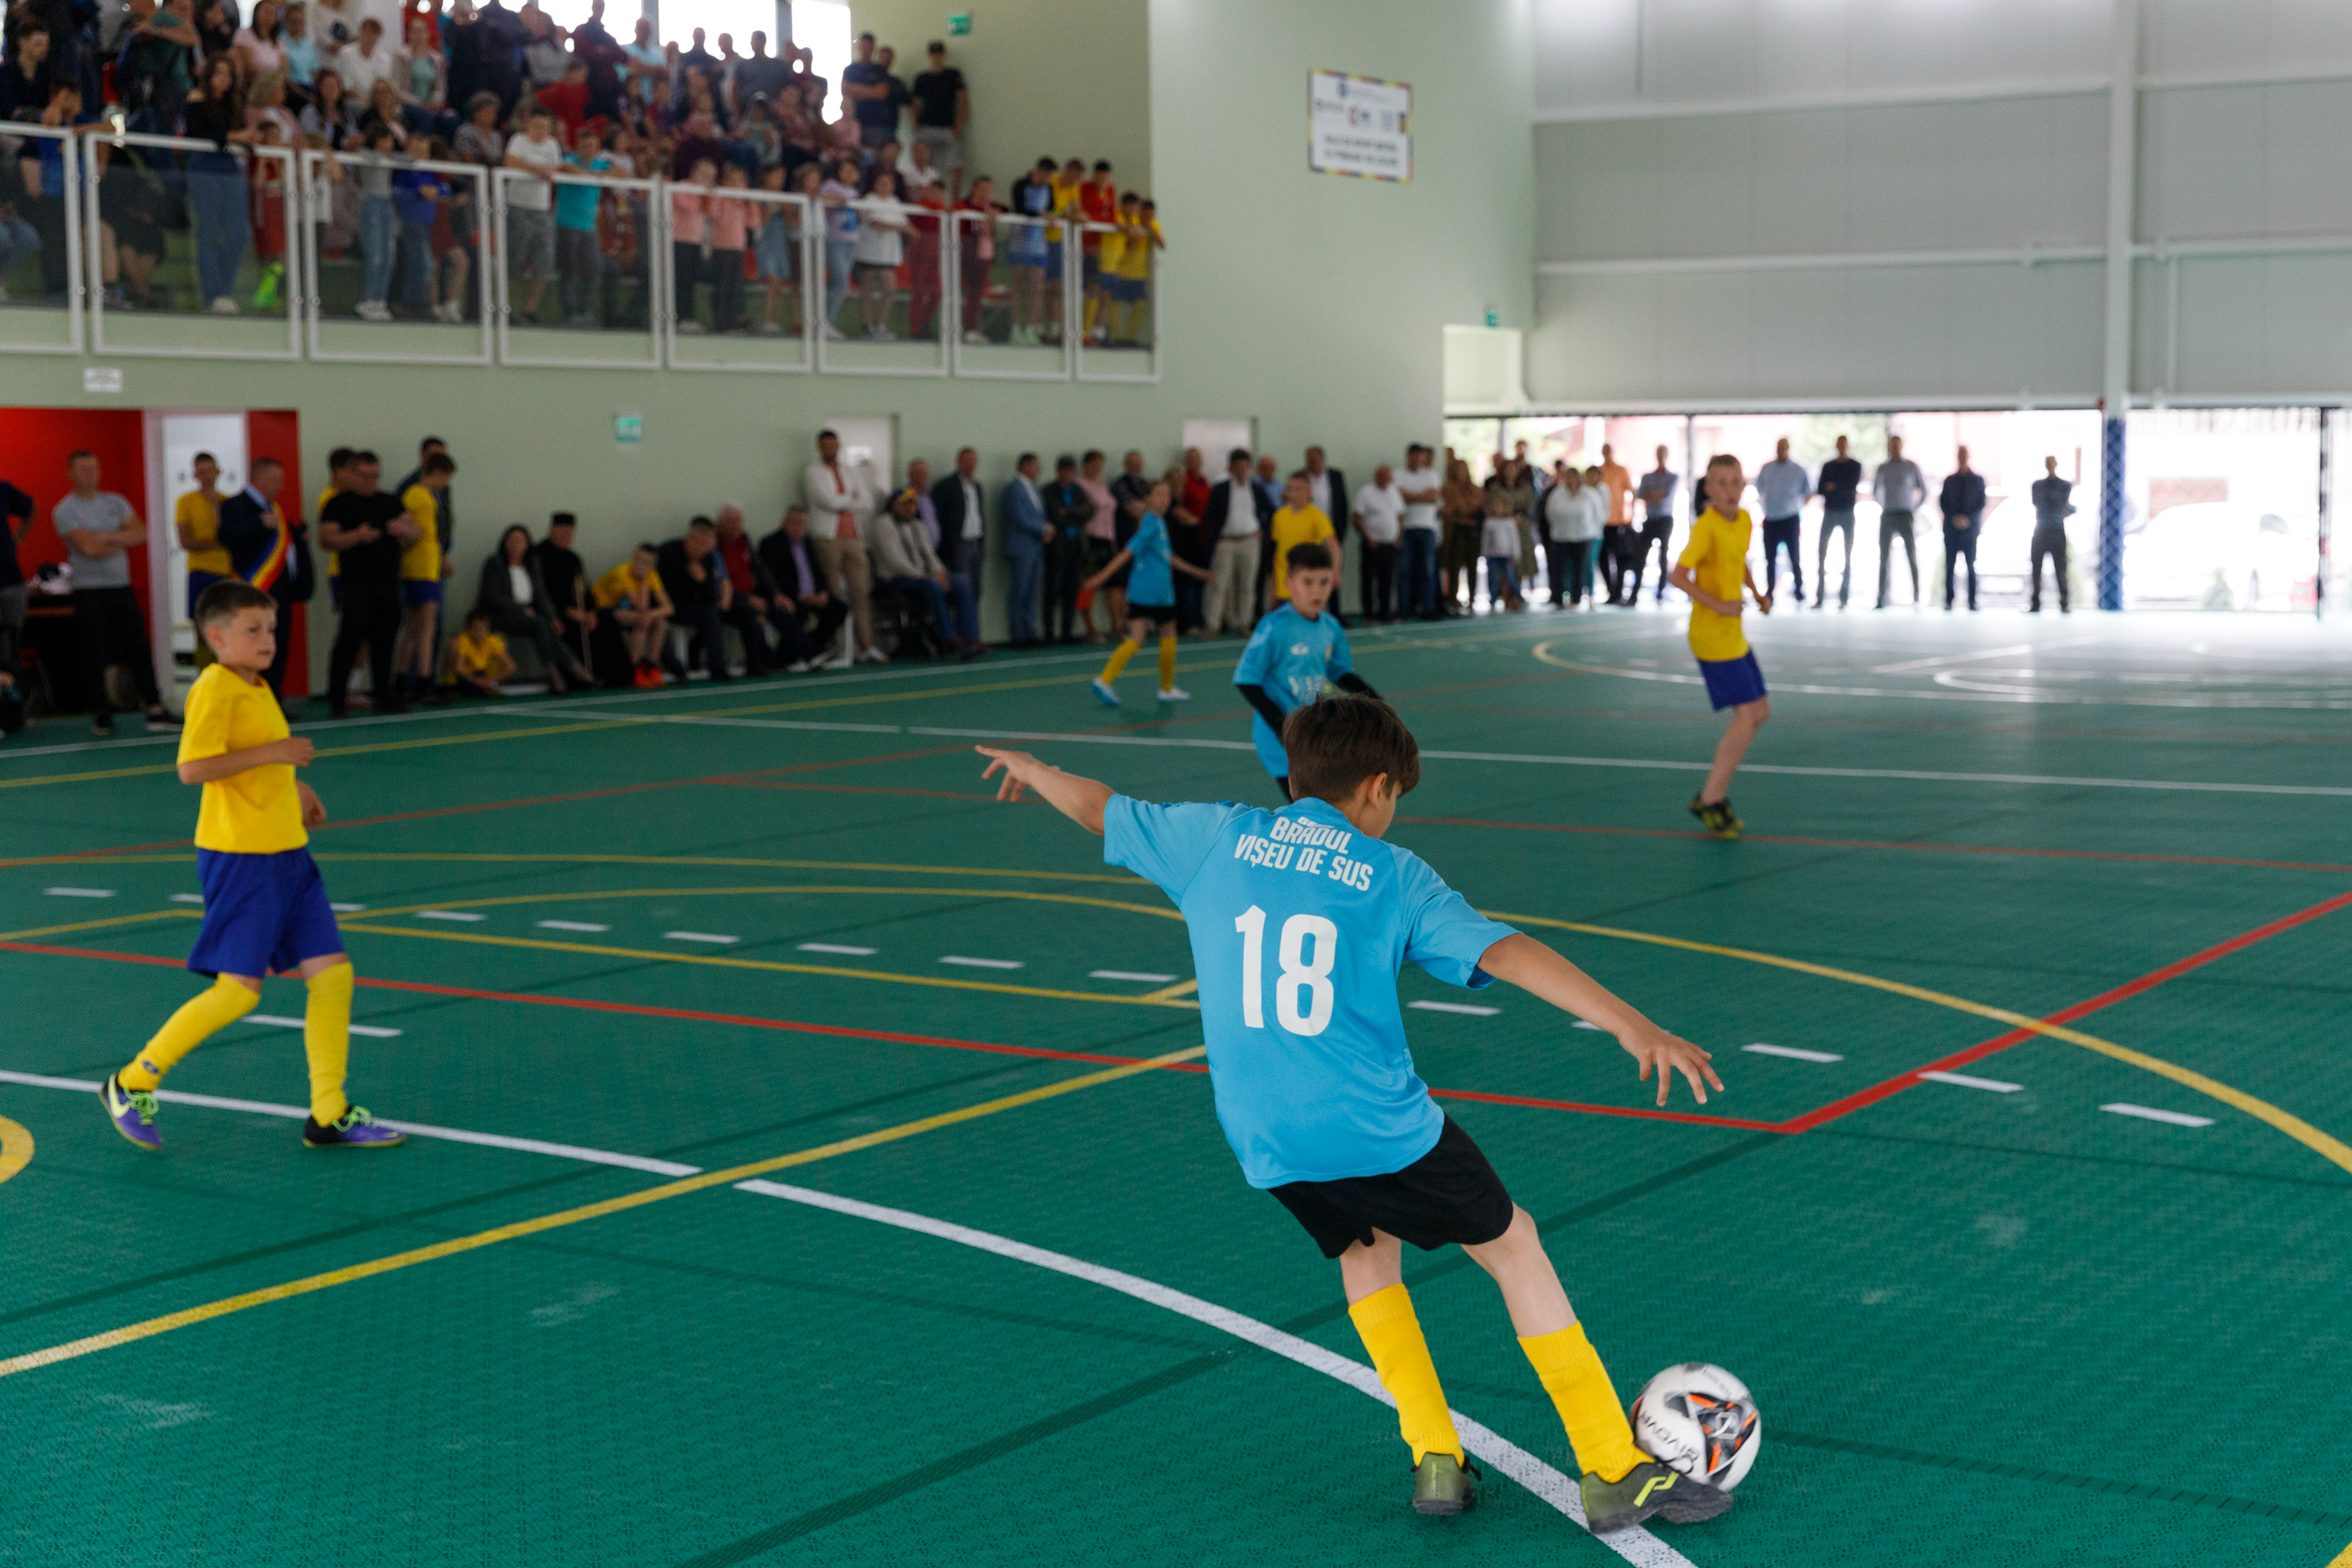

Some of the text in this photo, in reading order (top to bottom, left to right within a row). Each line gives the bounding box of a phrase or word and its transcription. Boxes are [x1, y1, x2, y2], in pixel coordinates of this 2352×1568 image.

[1234, 833, 1373, 891] VIȘEU DE SUS
[1269, 815, 1352, 855] BRADUL
[1234, 905, 1337, 1036] 18
